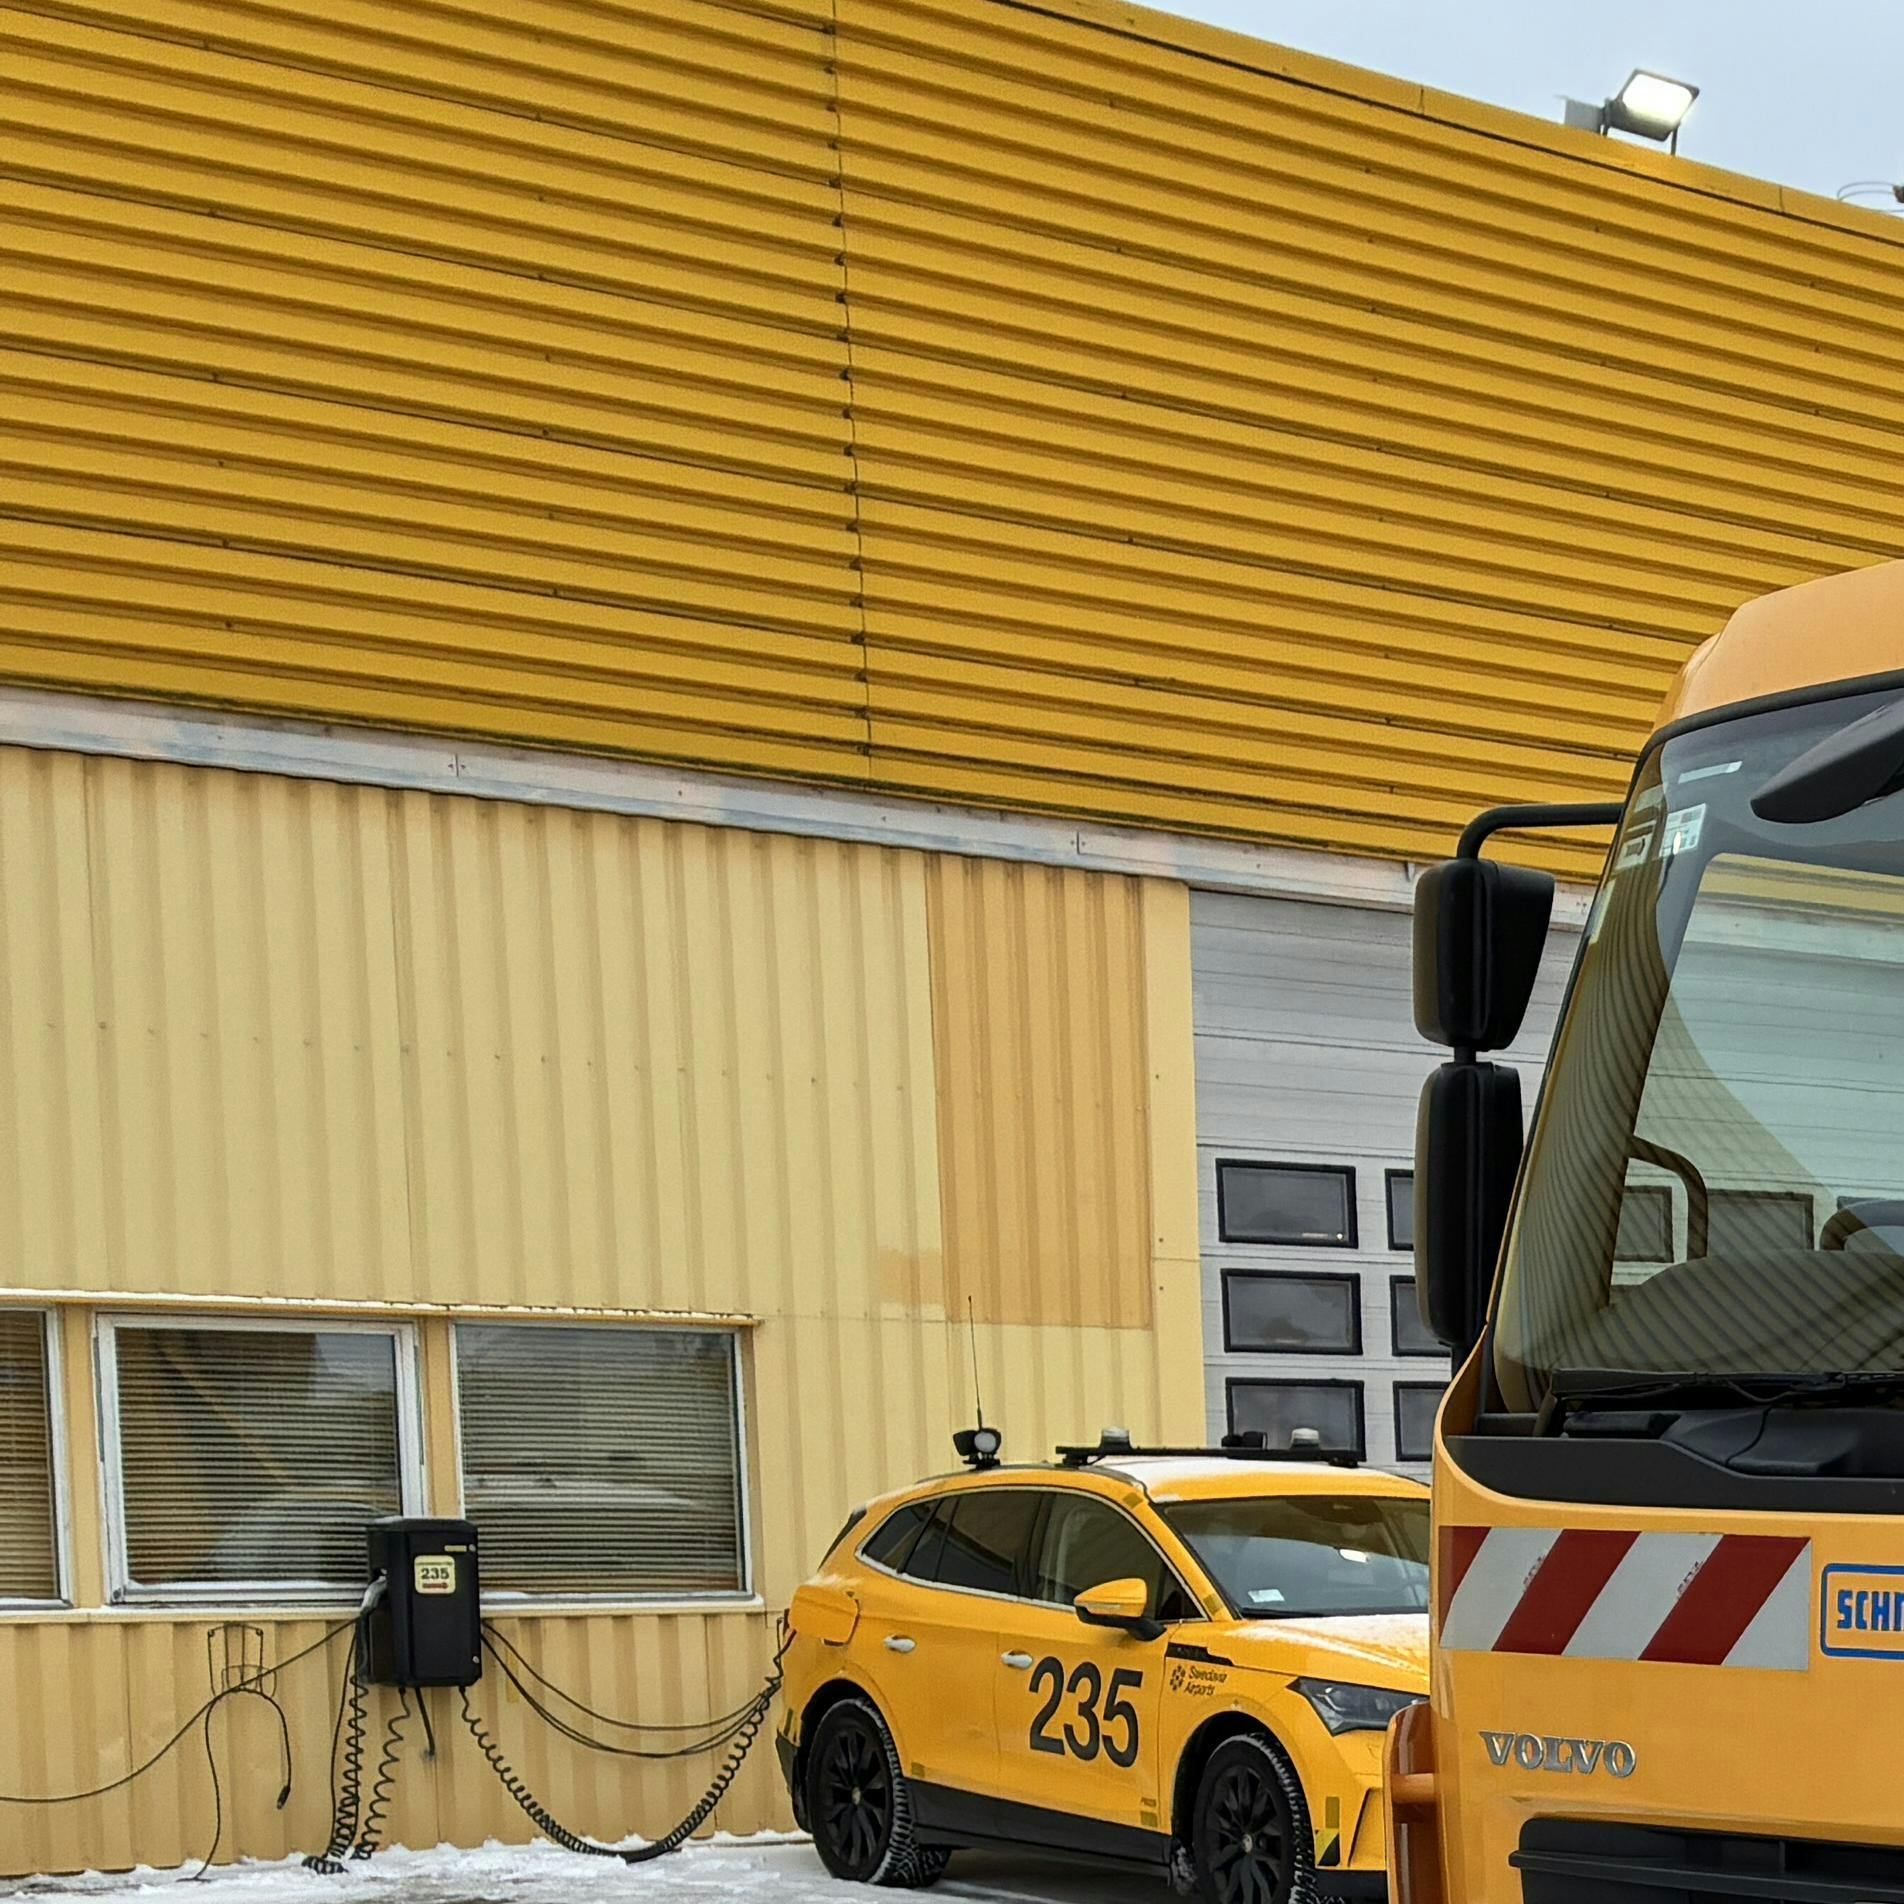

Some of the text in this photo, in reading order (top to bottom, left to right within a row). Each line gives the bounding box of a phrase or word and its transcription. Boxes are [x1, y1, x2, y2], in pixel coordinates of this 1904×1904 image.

[420, 1567, 450, 1580] 235
[1029, 1656, 1143, 1768] 235
[1479, 1730, 1637, 1778] VOLVO
